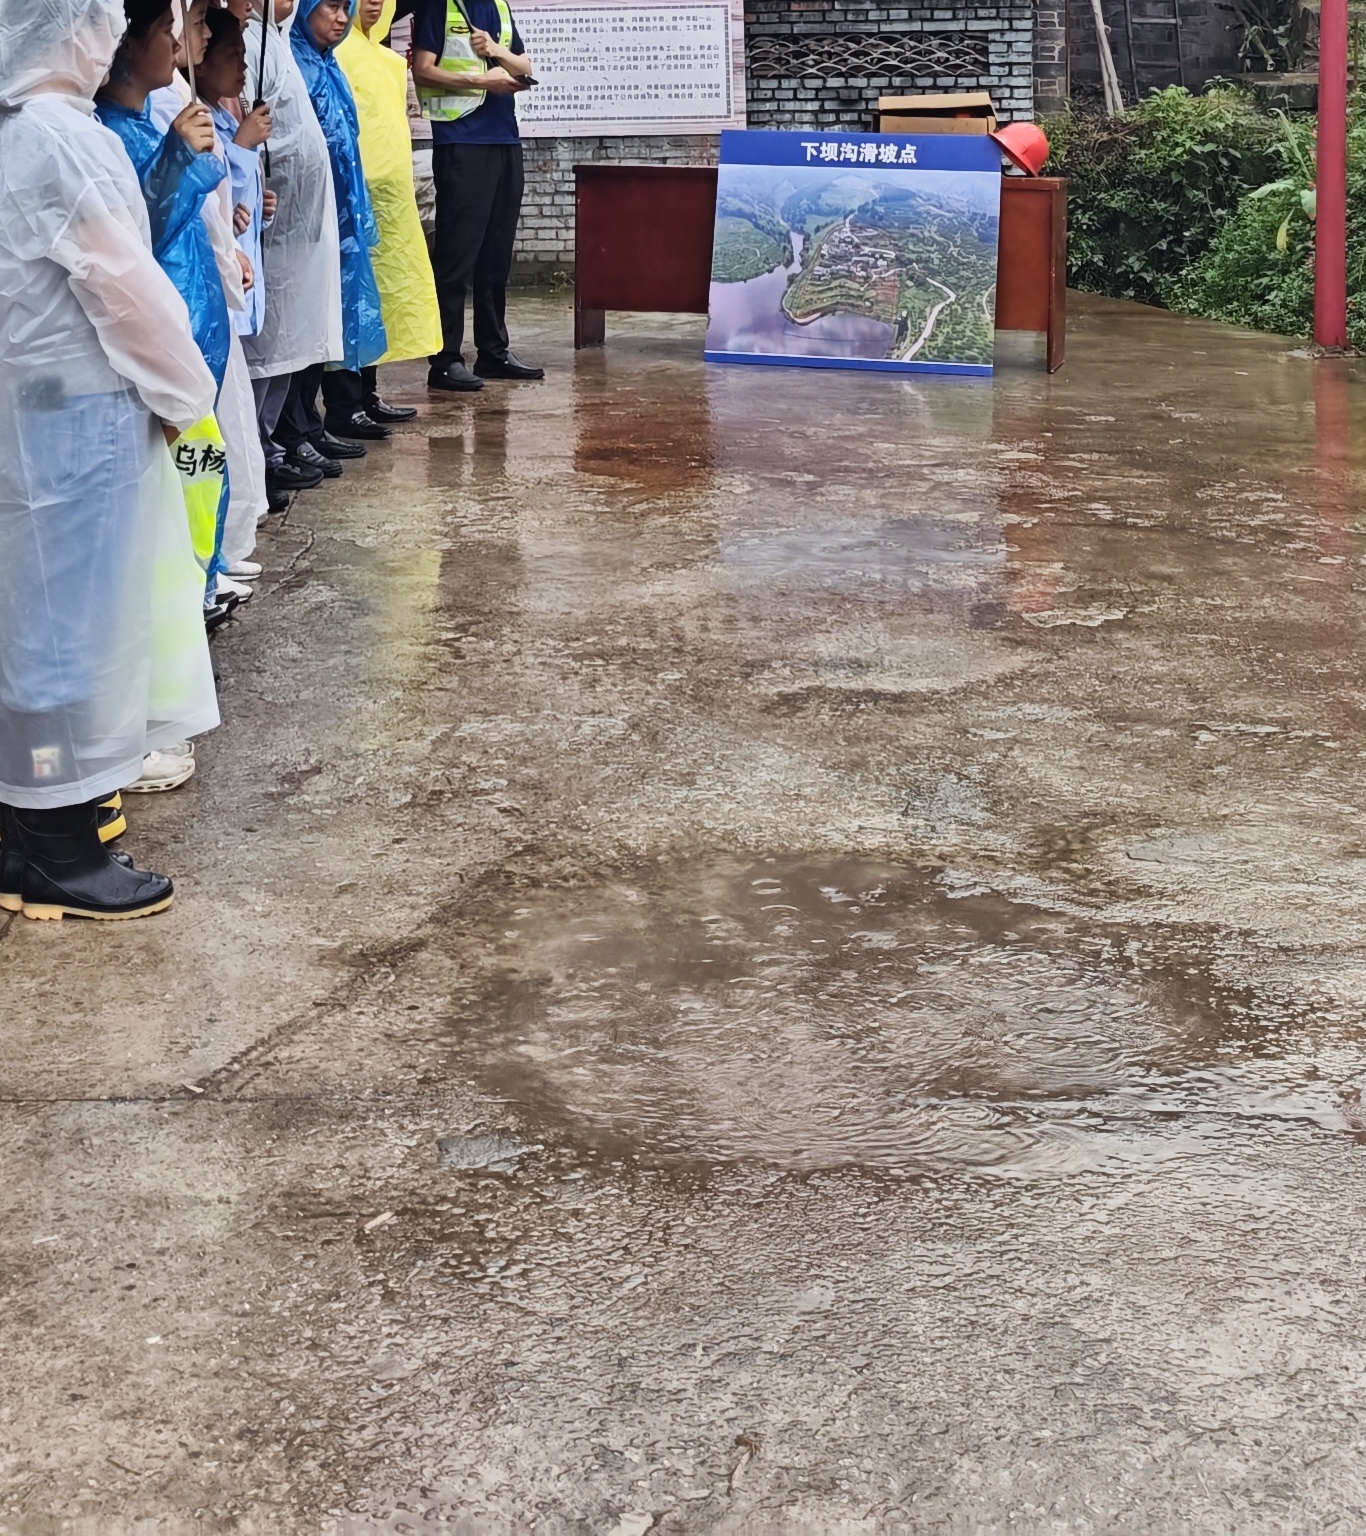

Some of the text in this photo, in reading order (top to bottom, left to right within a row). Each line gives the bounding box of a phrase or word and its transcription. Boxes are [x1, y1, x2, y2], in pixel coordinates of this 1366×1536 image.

[800, 141, 918, 164] 下坝沟滑坡点
[175, 443, 226, 477] 乌杨
